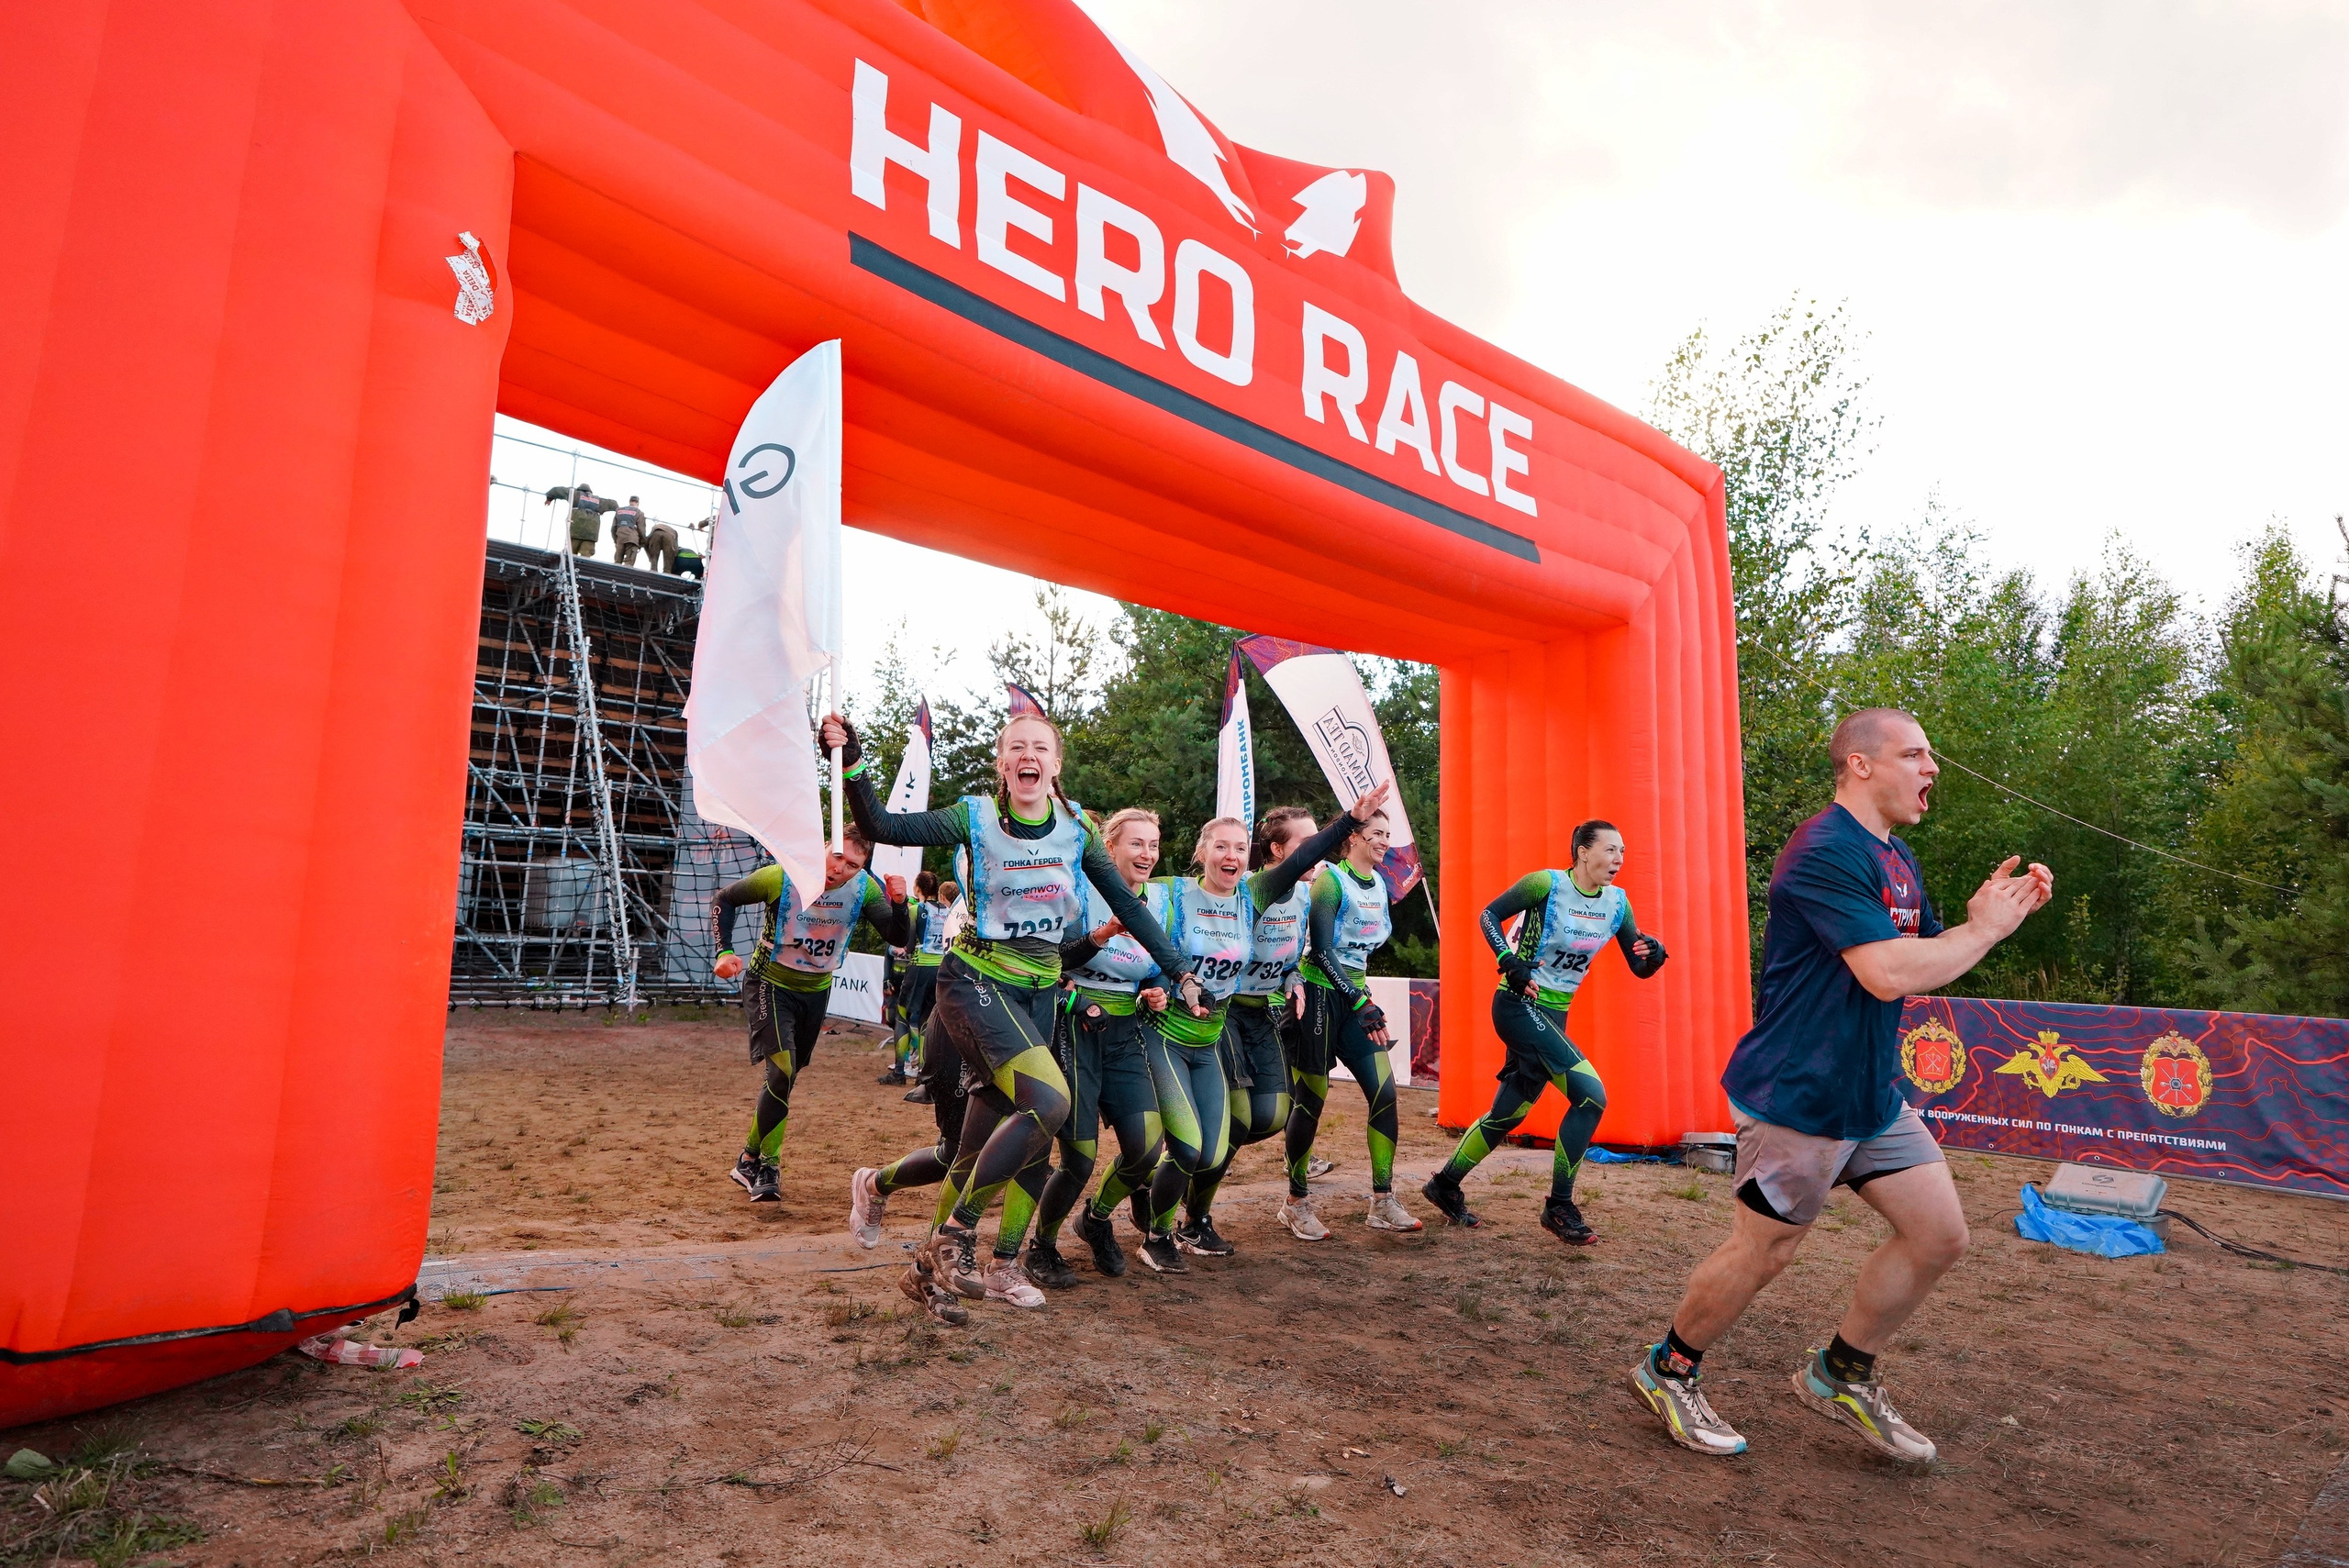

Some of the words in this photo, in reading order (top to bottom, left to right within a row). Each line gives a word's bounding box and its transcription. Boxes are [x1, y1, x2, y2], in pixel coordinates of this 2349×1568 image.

[462, 270, 480, 291] DELTA
[850, 57, 1255, 387] HERO
[1301, 301, 1538, 517] RACE
[1237, 718, 1252, 837] АЗПРОМБАНК
[1003, 859, 1031, 868] ГОНКА
[1033, 857, 1063, 866] ГЕРОЕВ
[1001, 884, 1061, 896] Greenway
[796, 914, 837, 925] Greenway
[1482, 909, 1507, 947] Greenway
[1564, 927, 1601, 940] Greenway
[794, 938, 836, 957] 7329
[1103, 946, 1138, 962] eenway
[1191, 954, 1242, 981] 7328
[1247, 960, 1286, 980] 732
[1551, 950, 1590, 973] 732
[832, 975, 869, 994] TANK
[1928, 1110, 2009, 1127] ВООРУЖЕННЫХ
[2011, 1118, 2032, 1129] СИЛ
[2036, 1122, 2052, 1131] ПО
[2054, 1123, 2103, 1138] ГОНКАМ
[2107, 1129, 2114, 1138] С
[2117, 1130, 2227, 1151] ПРЕПЯТСТВИЯМИ
